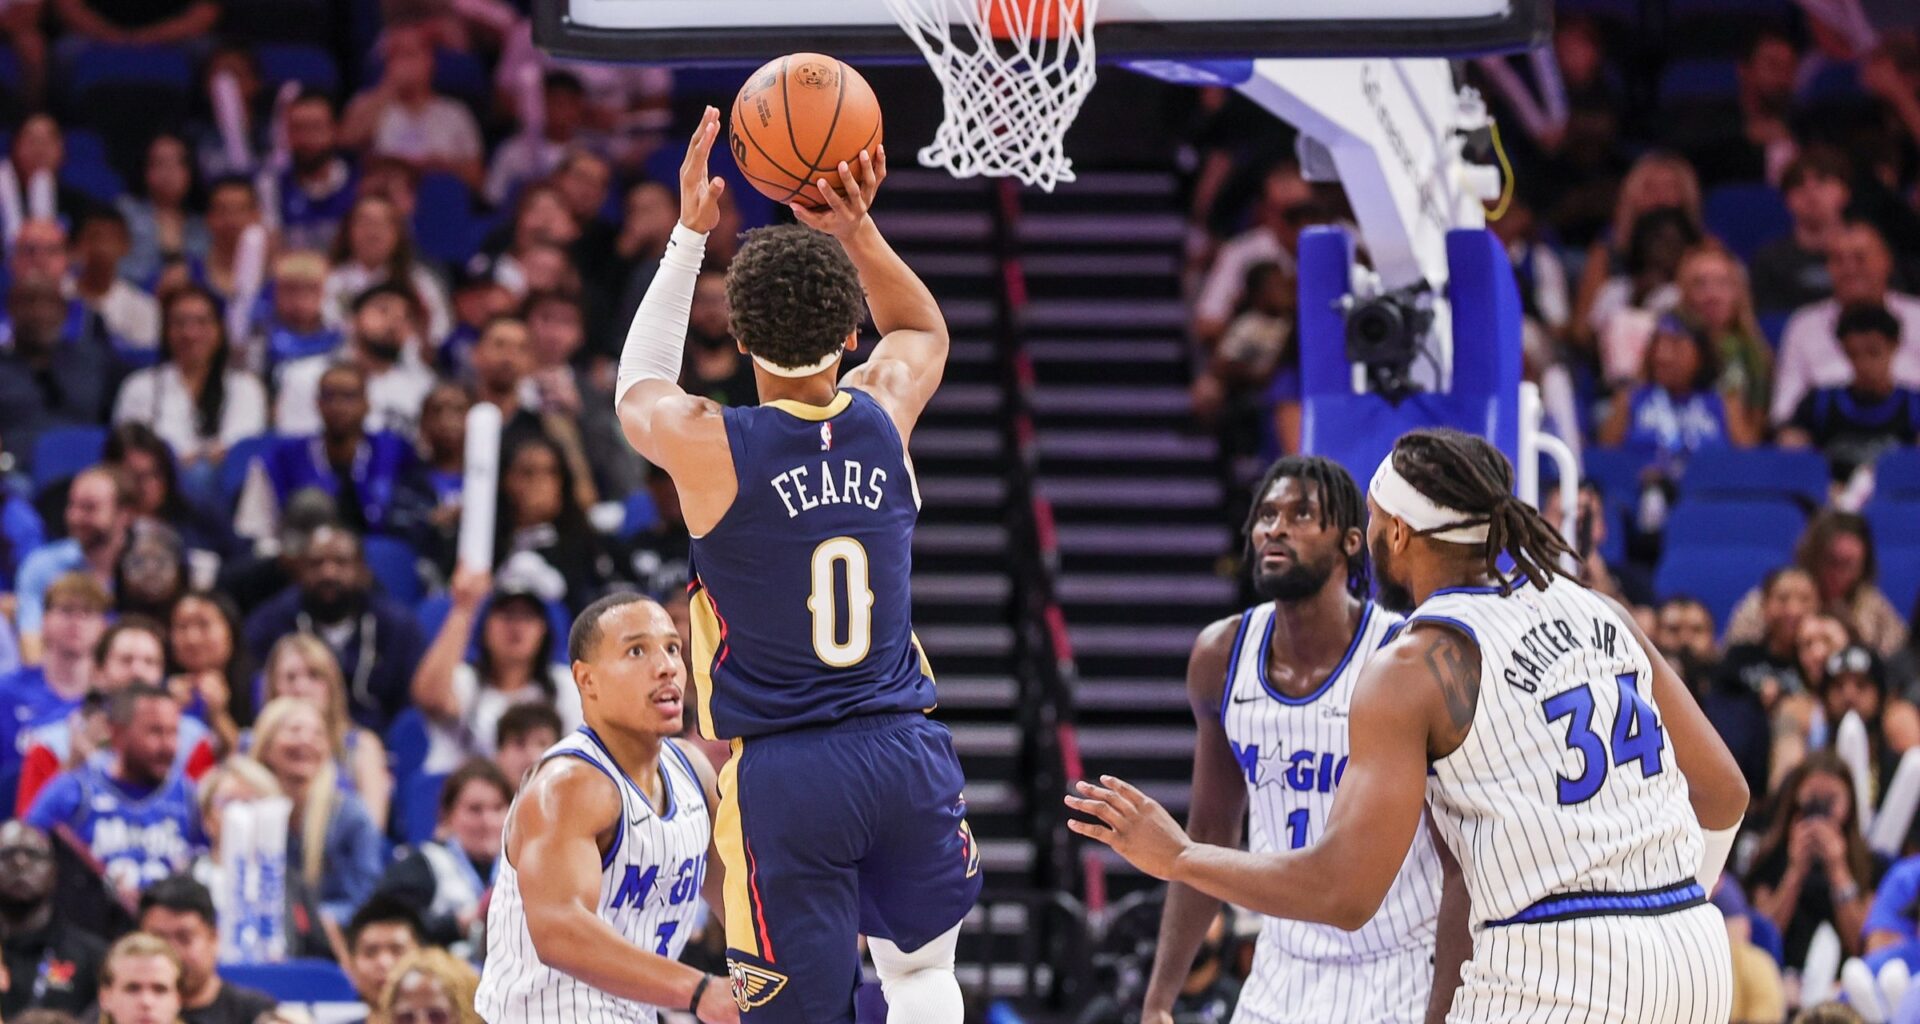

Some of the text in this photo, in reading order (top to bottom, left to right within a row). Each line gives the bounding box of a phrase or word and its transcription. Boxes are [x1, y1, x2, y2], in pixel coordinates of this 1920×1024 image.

[770, 459, 888, 519] FEARS
[806, 535, 875, 668] 0
[1503, 617, 1617, 694] CARTER JR
[1540, 671, 1665, 806] 34
